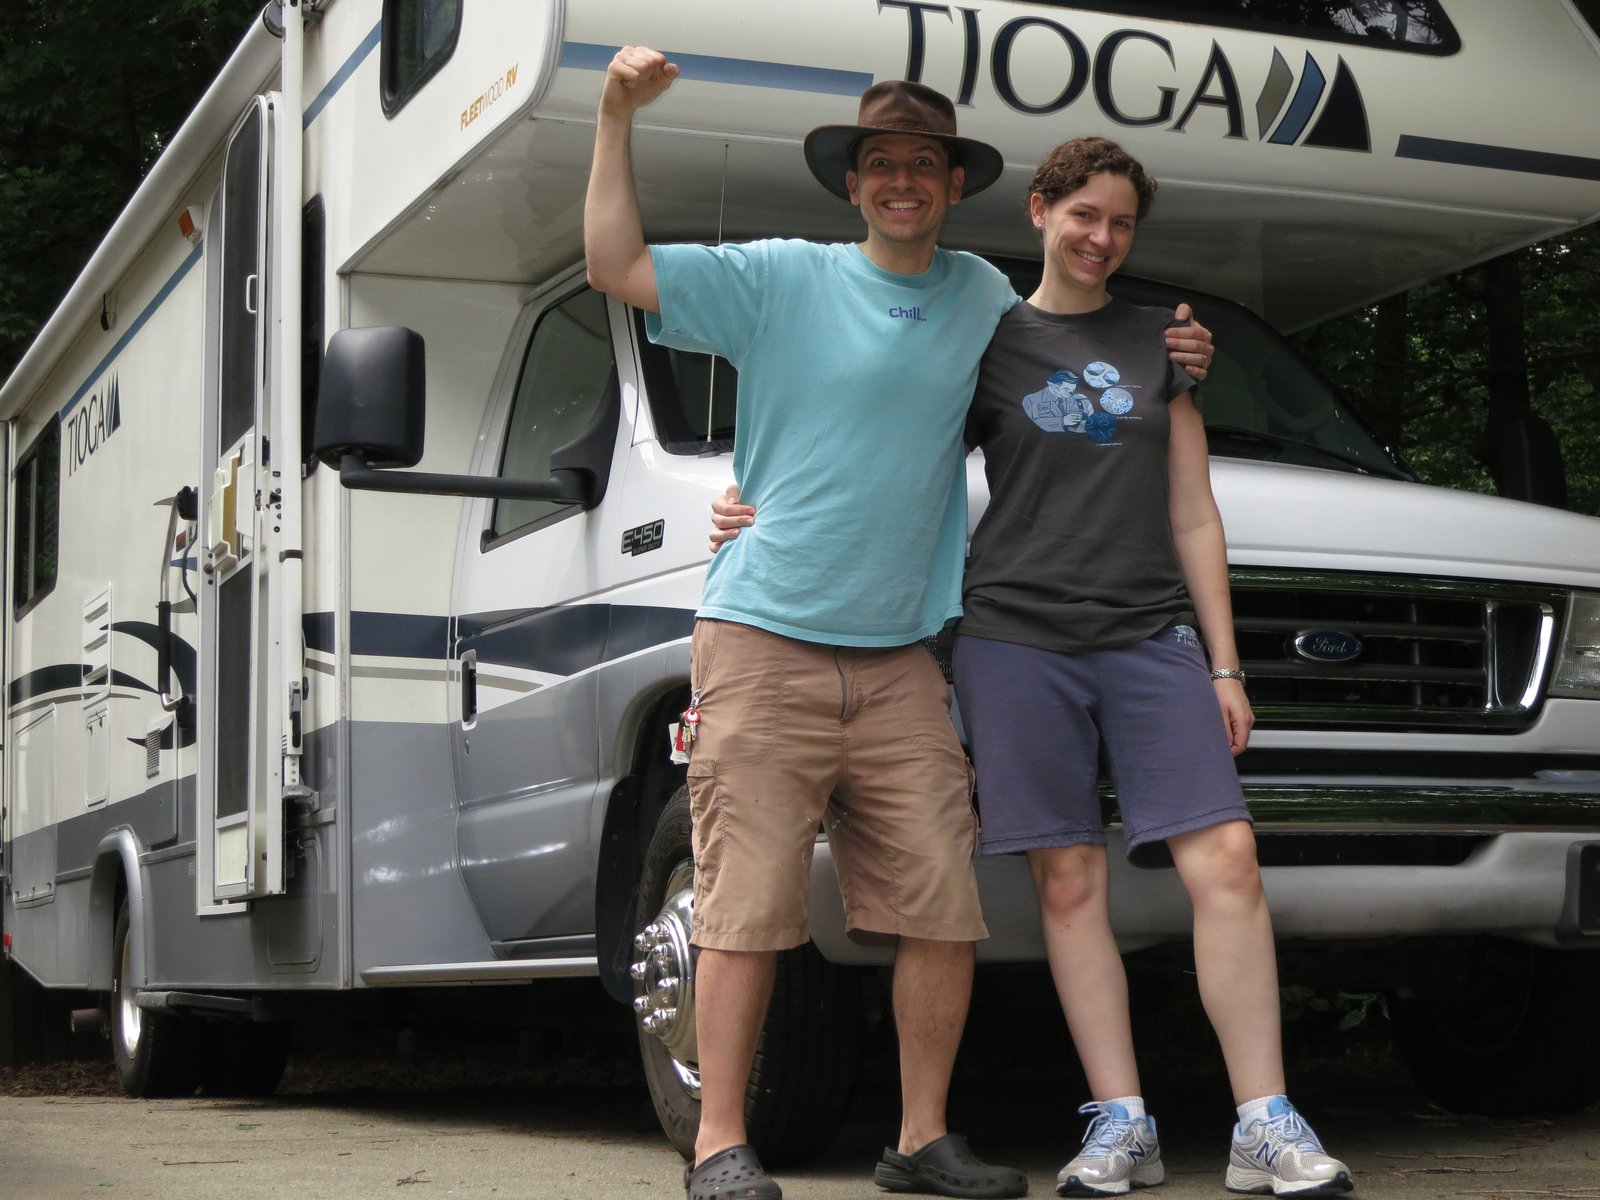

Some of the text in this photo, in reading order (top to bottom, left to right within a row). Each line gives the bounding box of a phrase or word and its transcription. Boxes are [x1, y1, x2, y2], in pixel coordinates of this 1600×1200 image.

[460, 63, 519, 132] FLEETWOOD RV
[879, 0, 1248, 141] TIOGA
[68, 385, 106, 477] TIOGA
[1313, 637, 1347, 653] Ford
[1255, 1140, 1280, 1168] N
